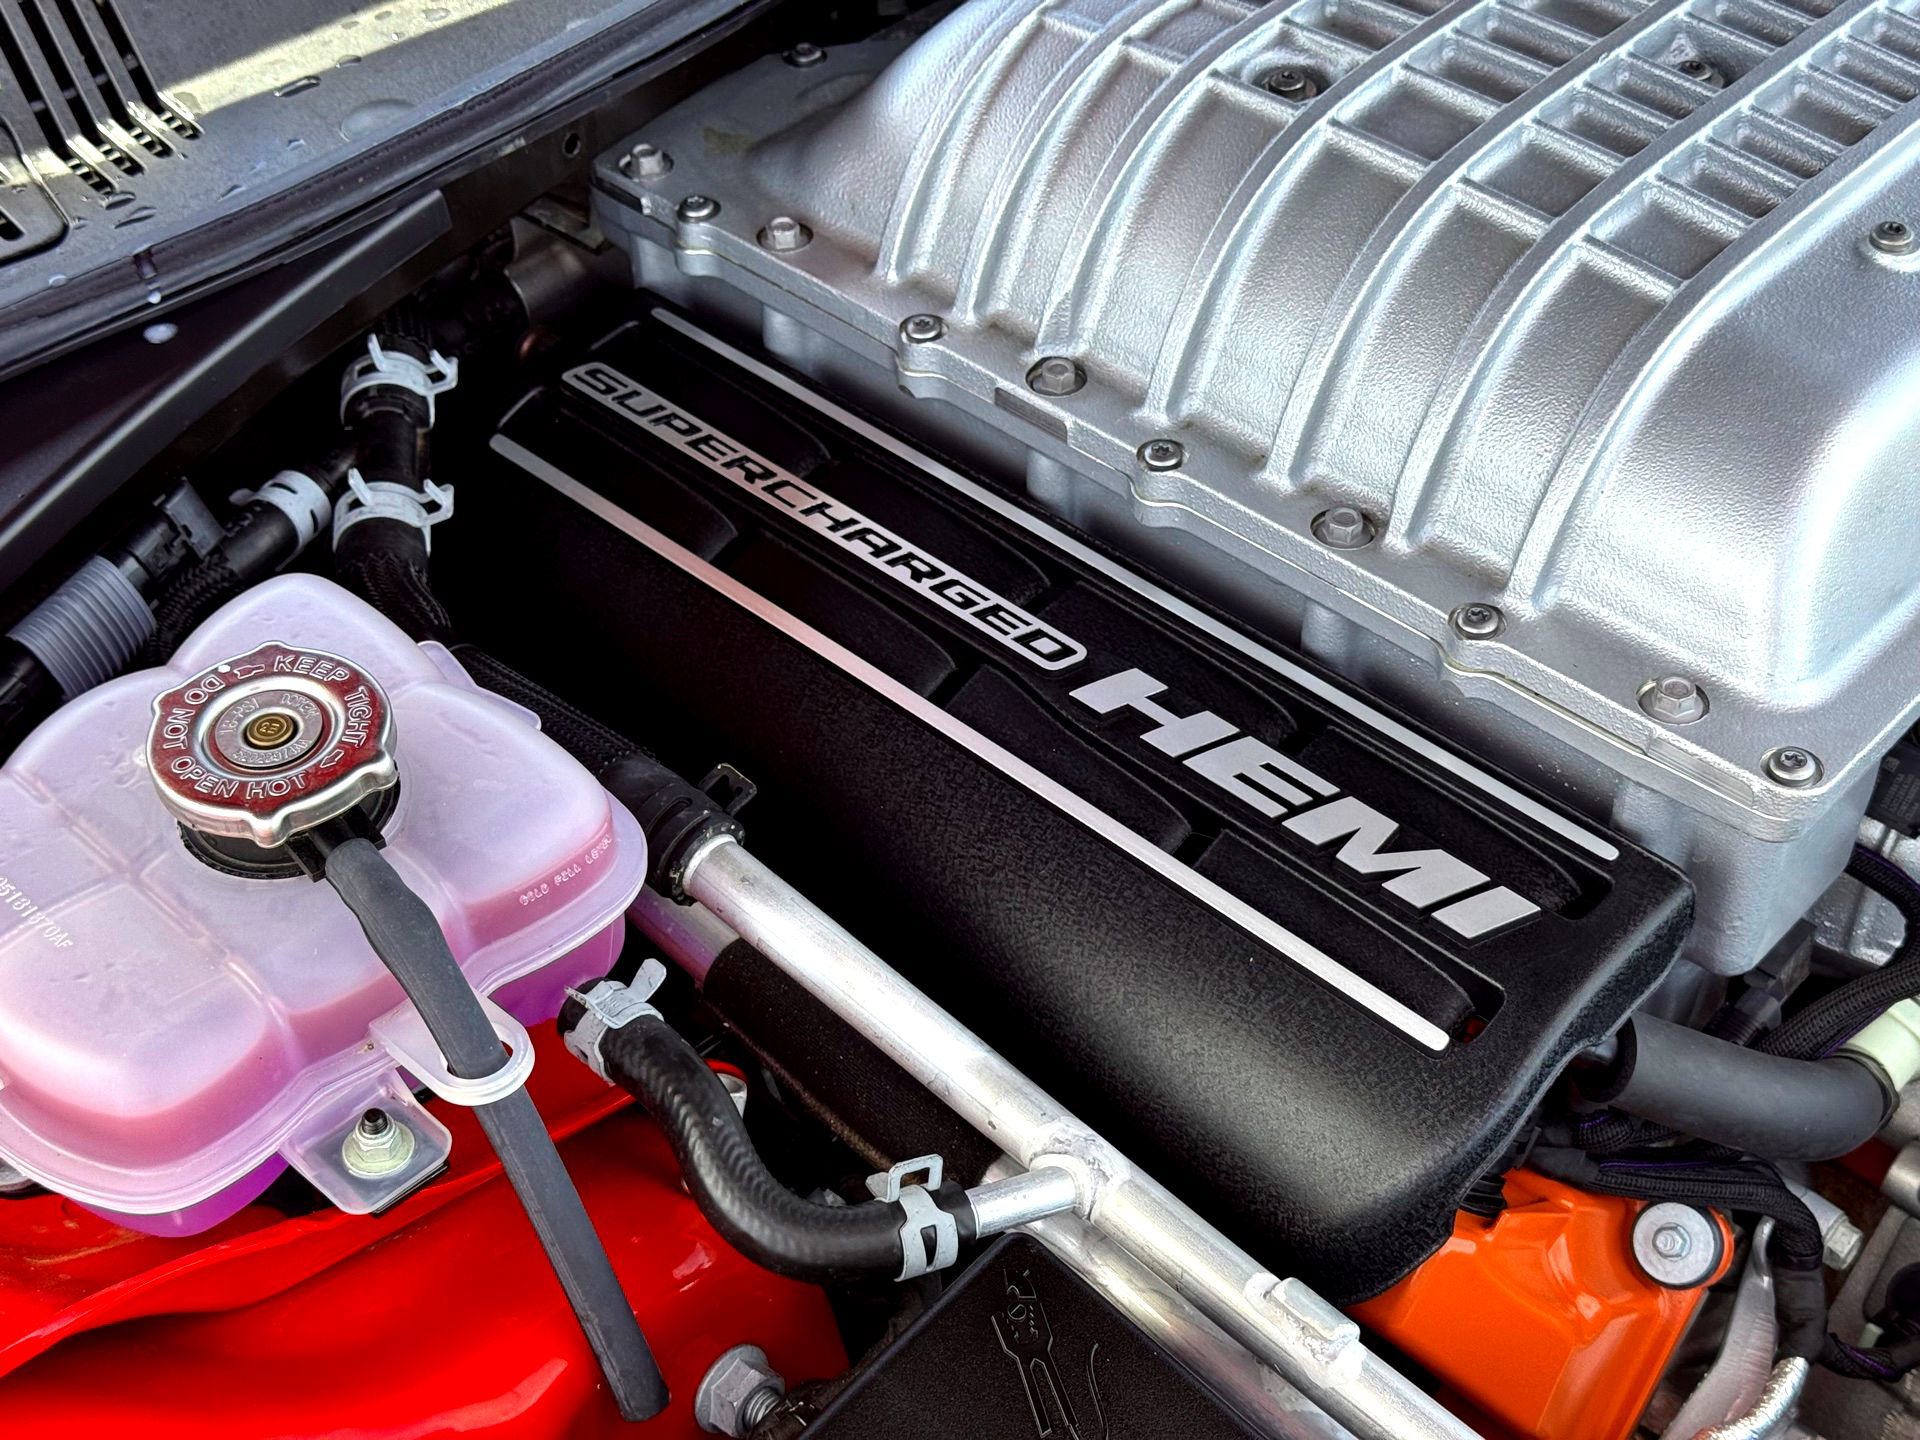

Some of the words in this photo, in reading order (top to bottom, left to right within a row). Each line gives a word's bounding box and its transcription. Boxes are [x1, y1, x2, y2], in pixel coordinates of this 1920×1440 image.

[571, 365, 1078, 663] SUPERCHARGED
[1068, 667, 1543, 942] HEMI
[184, 673, 226, 706] DO
[273, 655, 350, 683] KEEP
[344, 685, 373, 748] TIGHT
[162, 707, 196, 751] NOT
[170, 755, 239, 799] OPEN
[245, 771, 307, 800] HOT
